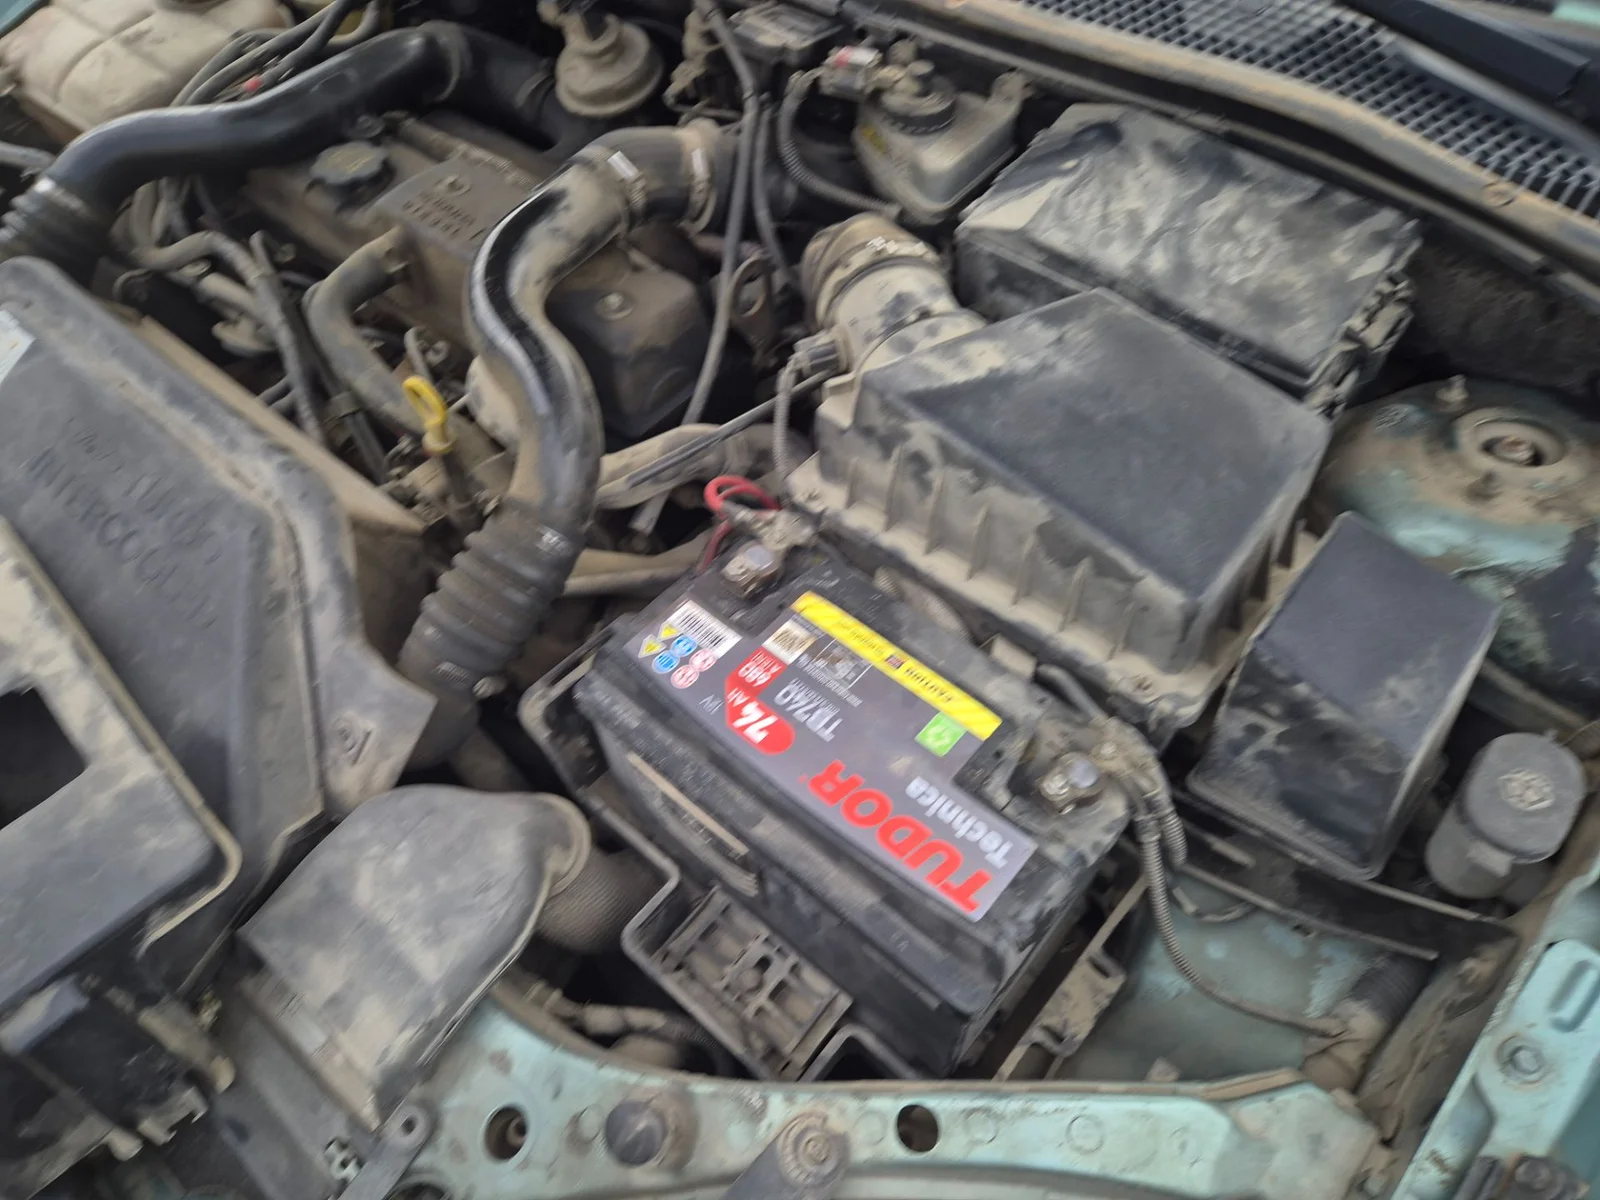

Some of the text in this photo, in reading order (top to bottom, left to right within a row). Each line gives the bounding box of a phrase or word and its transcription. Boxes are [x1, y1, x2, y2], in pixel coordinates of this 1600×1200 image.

[732, 701, 779, 744] 74
[774, 680, 843, 742] TB740
[807, 758, 993, 915] TUDOR
[905, 776, 1014, 869] Technica
